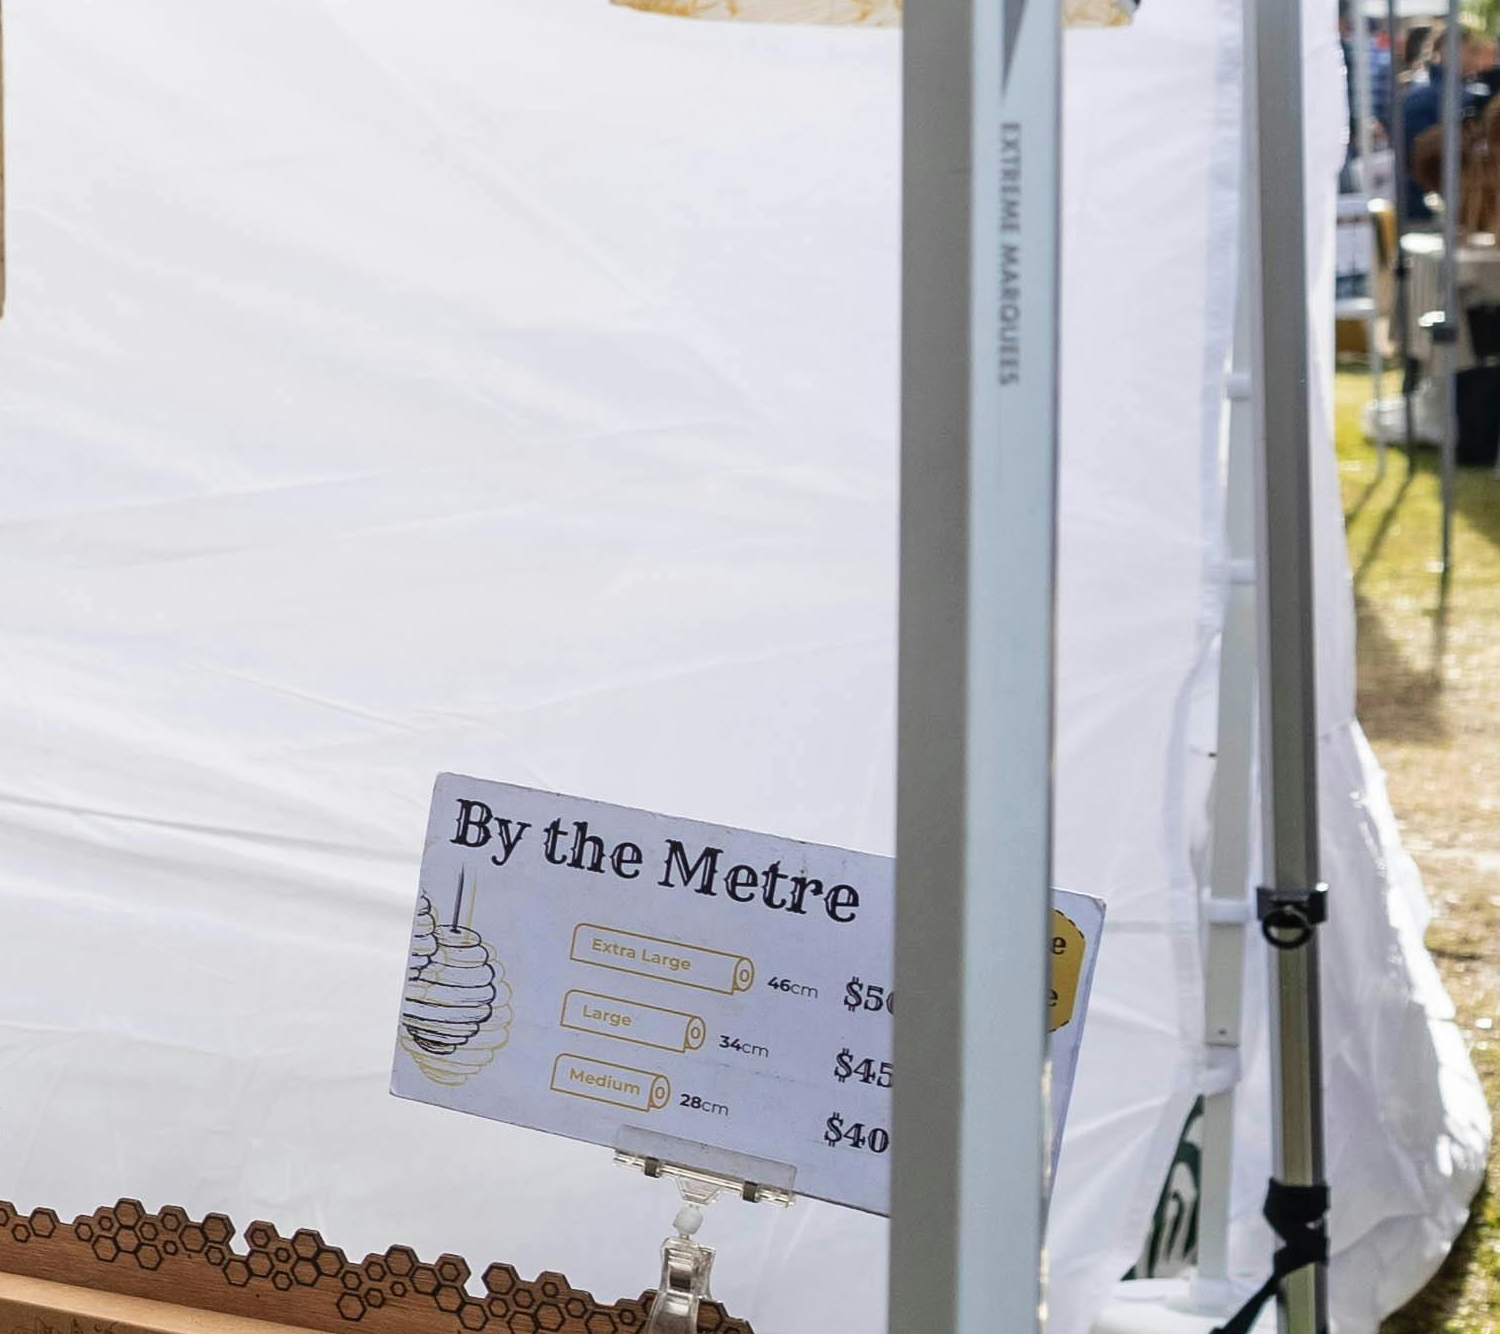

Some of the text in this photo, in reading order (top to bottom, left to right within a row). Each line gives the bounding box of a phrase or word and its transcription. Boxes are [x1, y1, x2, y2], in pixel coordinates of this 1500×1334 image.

[998, 121, 1022, 388] EXTREME MARQUEES
[449, 796, 862, 925] By the Metre
[591, 937, 819, 999] Extra Large 46cm
[582, 1003, 632, 1027] Large
[719, 1034, 770, 1058] 34cm
[569, 1067, 889, 1154] Medium 28cm $40
